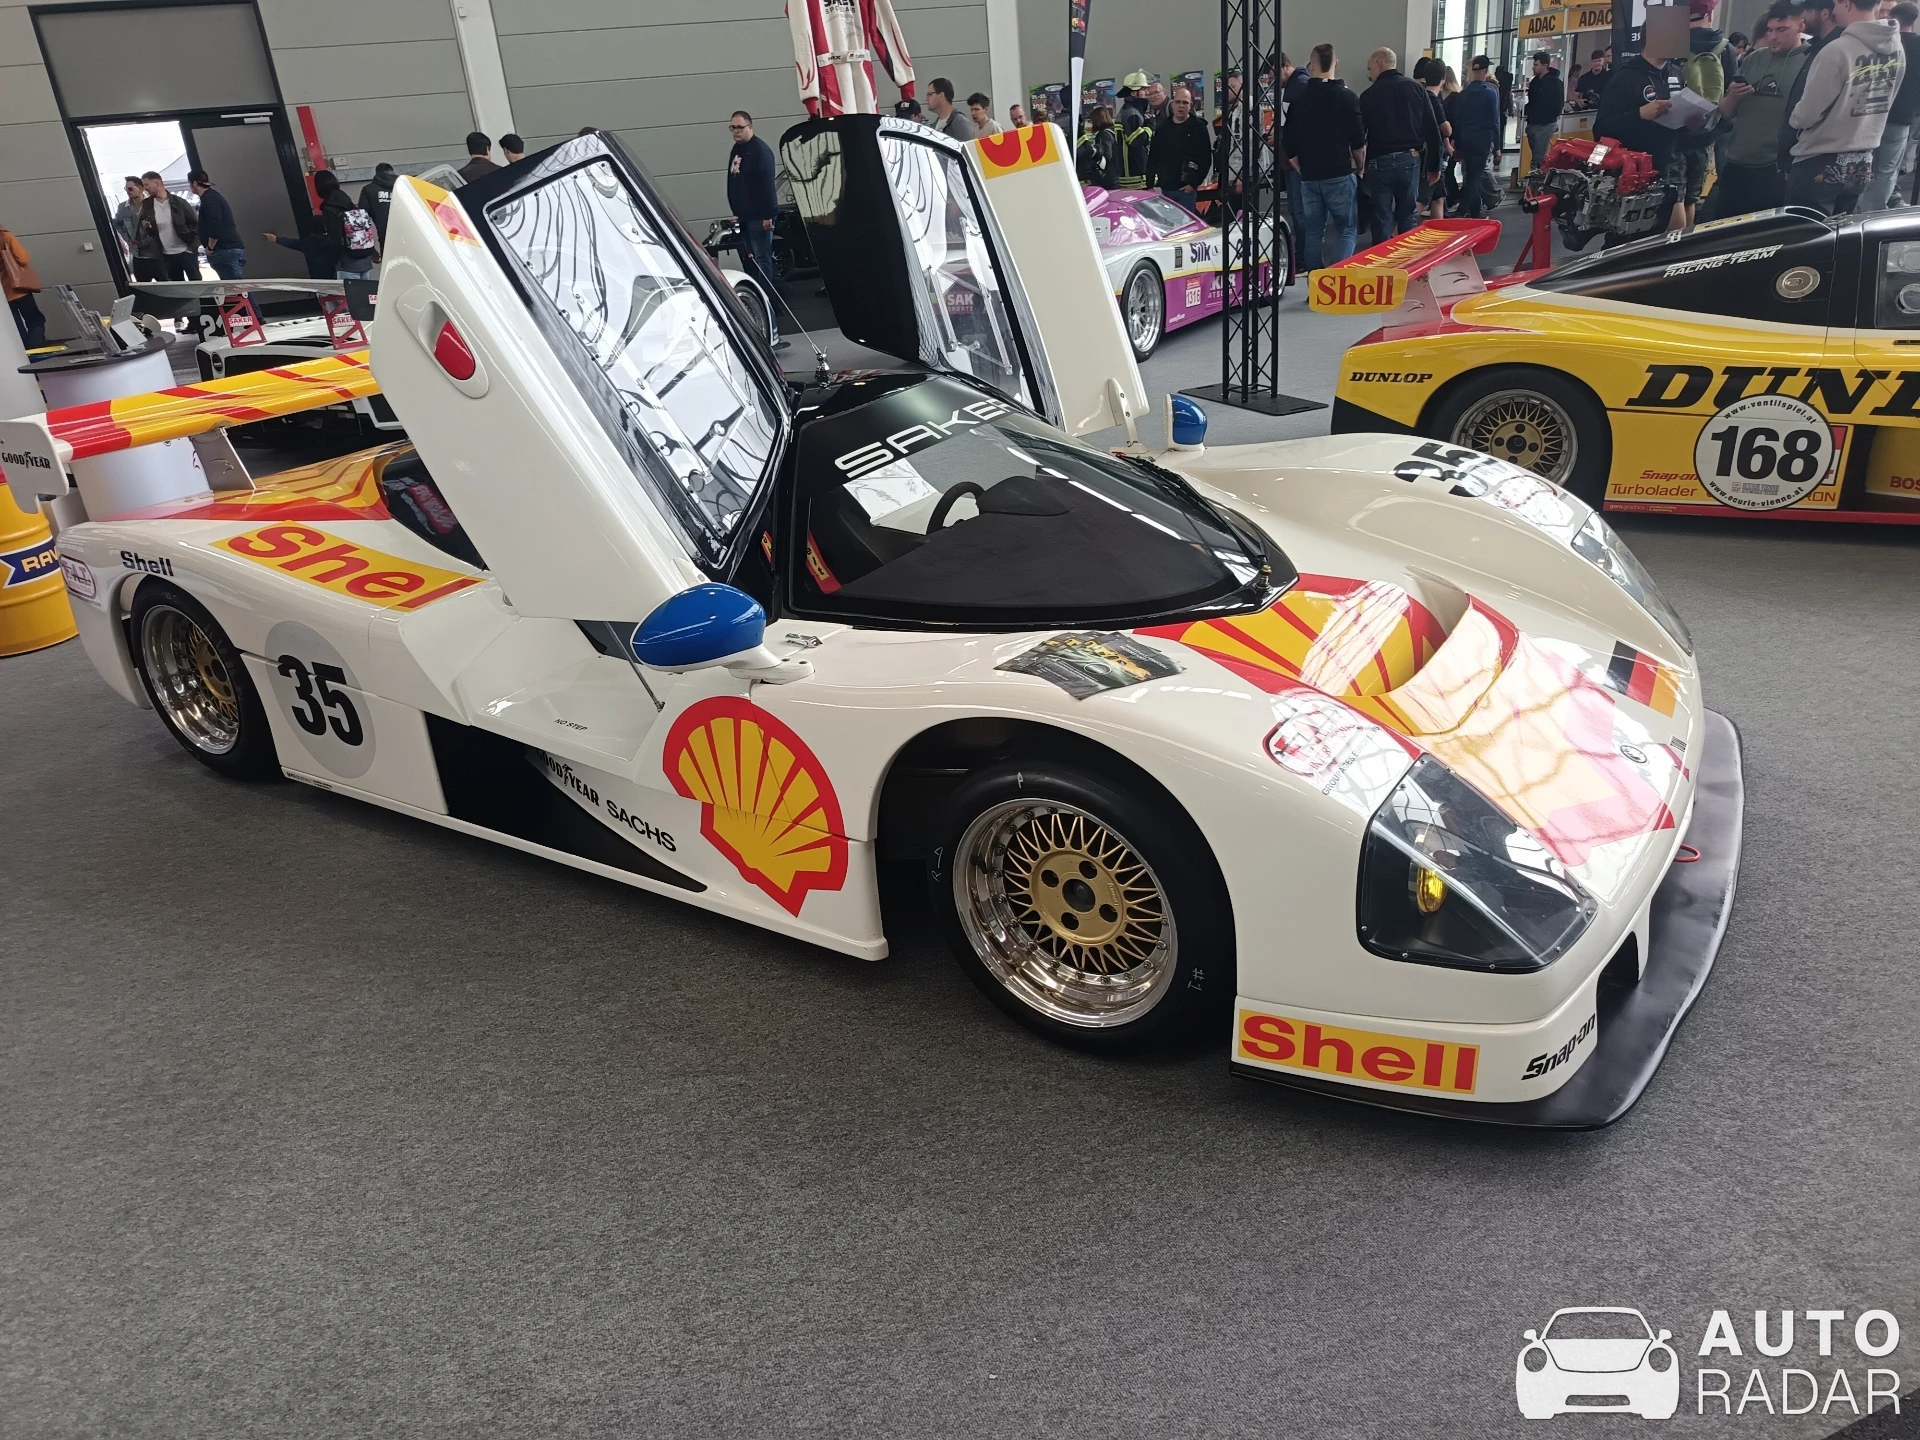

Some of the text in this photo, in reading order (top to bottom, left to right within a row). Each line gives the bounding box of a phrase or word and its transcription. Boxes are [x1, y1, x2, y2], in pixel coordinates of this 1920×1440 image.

[1528, 15, 1556, 34] ADAC
[1579, 9, 1612, 27] ADAC
[1664, 250, 1776, 279] RACING-TEAM
[1186, 289, 1201, 307] 1316
[1316, 275, 1394, 306] Shell
[229, 316, 253, 325] SAKER
[1349, 371, 1433, 383] DUNLOP
[1723, 399, 1818, 424] www.ventilspiel.at
[835, 398, 1011, 479] SAKER
[1, 452, 51, 469] GOODYEAR
[1709, 424, 1822, 483] 168
[1640, 470, 1699, 482] Snap-on
[1611, 484, 1698, 497] Turbolader
[1709, 480, 1804, 507] www.ecurie-vienne.at
[120, 550, 175, 578] Shell
[277, 655, 364, 747] 35
[537, 750, 677, 853] GOODYEAR SACHS
[1241, 1015, 1477, 1091] Shell
[1520, 1012, 1596, 1081] Snap-on
